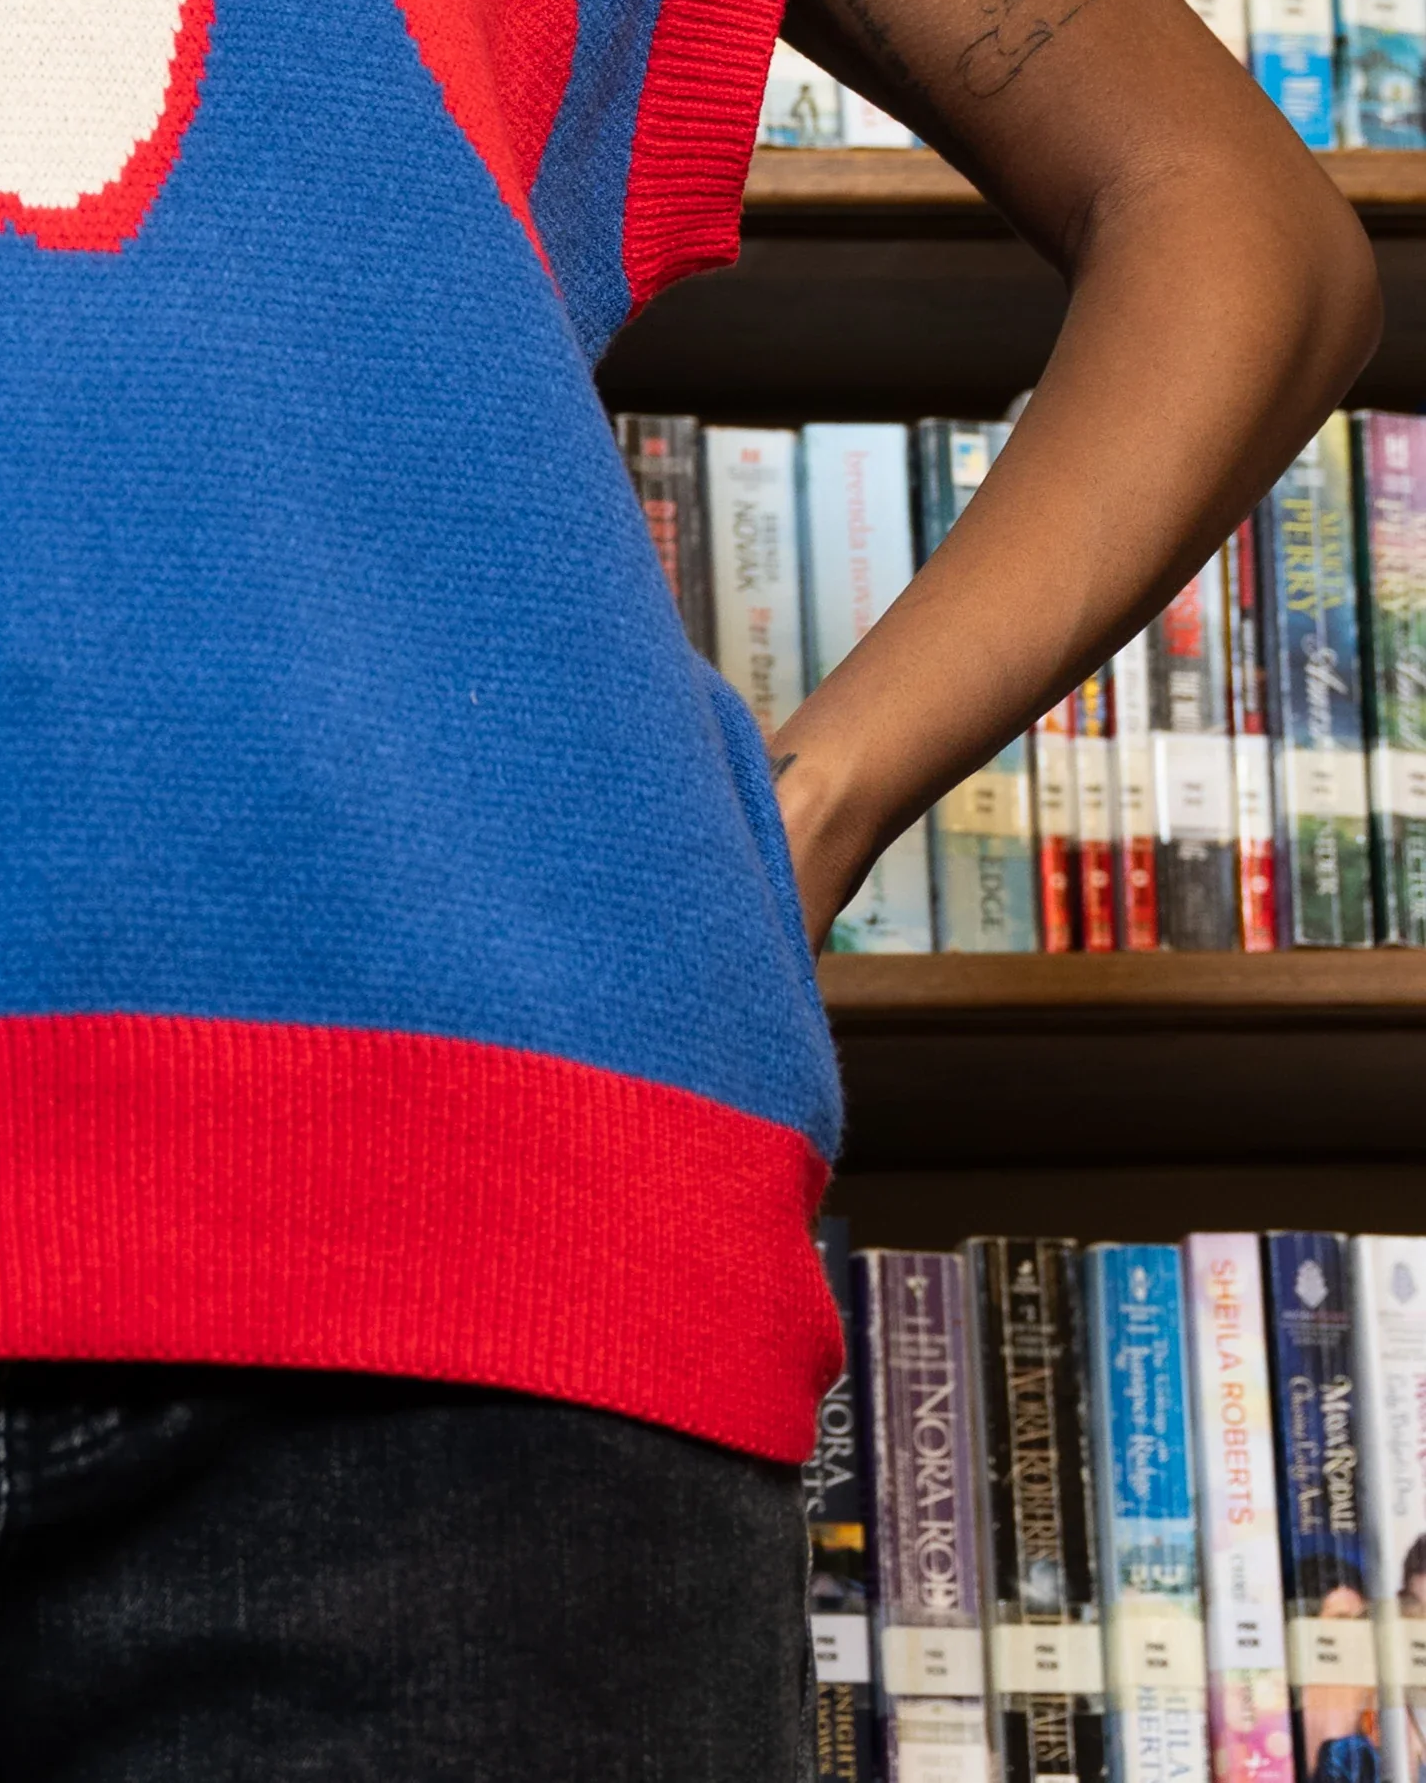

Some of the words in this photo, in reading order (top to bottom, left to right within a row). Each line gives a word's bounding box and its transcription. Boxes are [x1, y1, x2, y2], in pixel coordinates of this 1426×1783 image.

[732, 500, 758, 593] NOVAK
[845, 451, 874, 551] brenda
[1283, 499, 1318, 619] PERRY
[978, 857, 1006, 933] EDGE
[1210, 1258, 1241, 1371] SHEILA
[822, 1375, 855, 1489] NORA
[914, 1382, 956, 1507] NORA
[1008, 1369, 1055, 1439] NORA
[1220, 1381, 1256, 1526] ROBERTS
[1011, 1449, 1059, 1563] ROBERTS
